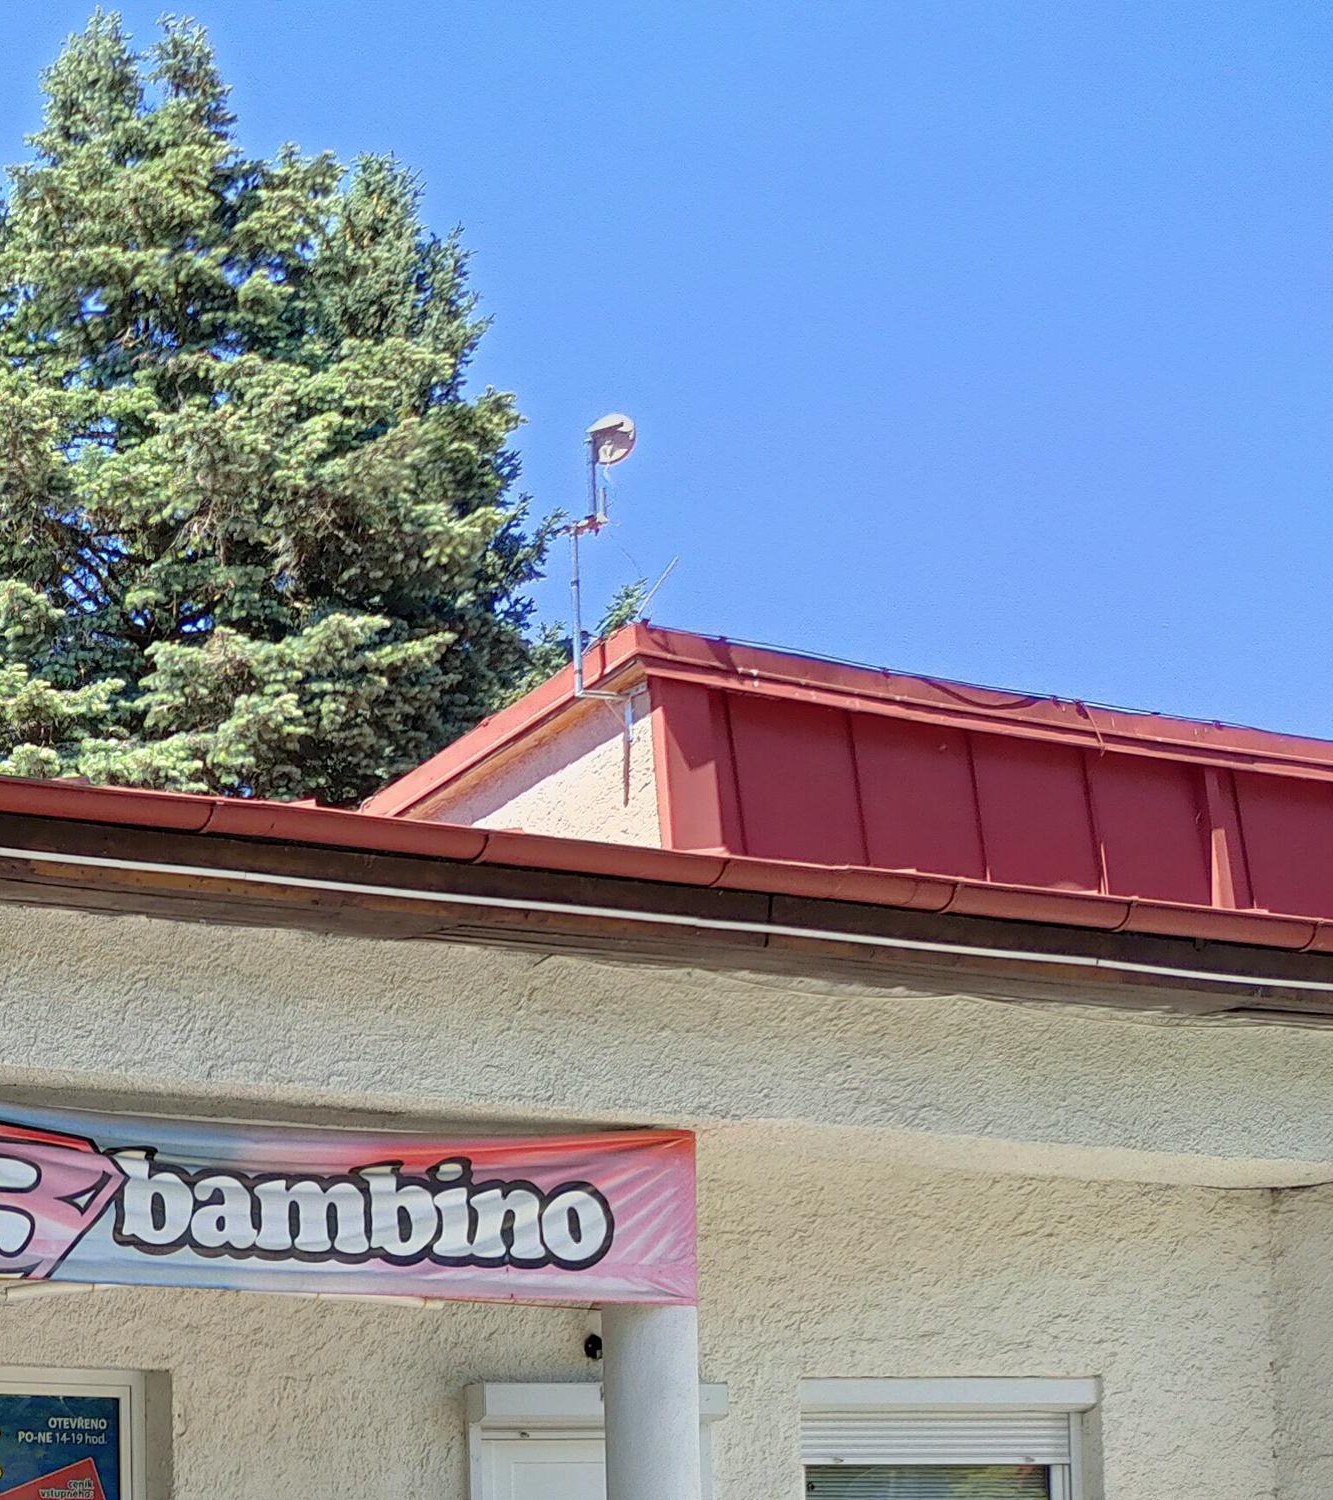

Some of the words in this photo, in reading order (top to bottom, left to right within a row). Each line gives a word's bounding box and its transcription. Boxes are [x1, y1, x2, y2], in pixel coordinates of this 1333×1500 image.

[114, 1148, 615, 1270] bambino
[47, 1416, 108, 1430] OTEVŘENO
[18, 1430, 53, 1444] PO-NE
[55, 1432, 83, 1445] 14-19
[85, 1433, 108, 1445] hod.
[68, 1478, 94, 1490] ceník
